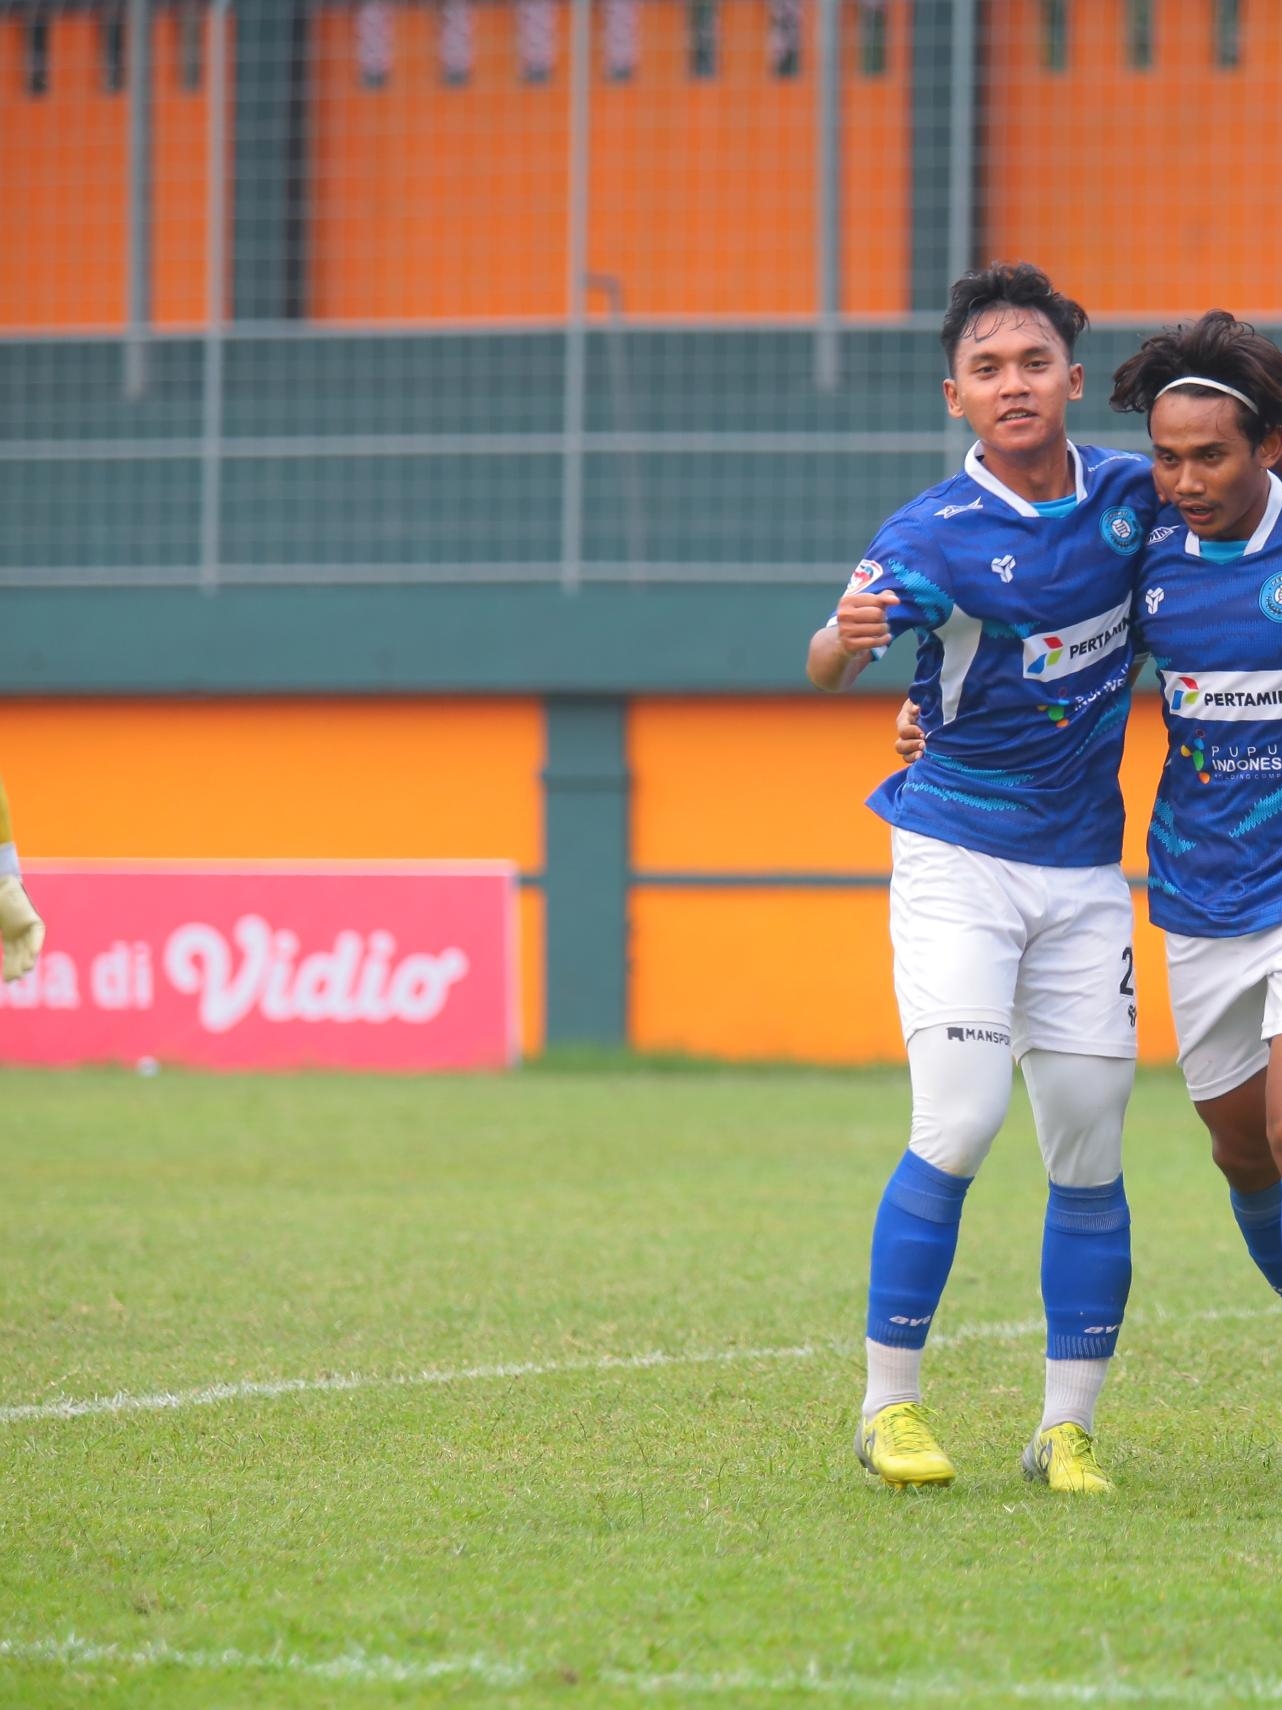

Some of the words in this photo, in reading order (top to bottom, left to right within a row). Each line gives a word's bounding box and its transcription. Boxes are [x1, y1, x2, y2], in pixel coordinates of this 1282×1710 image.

[1069, 616, 1131, 659] PERTAMIN
[91, 941, 154, 1010] di
[165, 916, 469, 1032] Vidio
